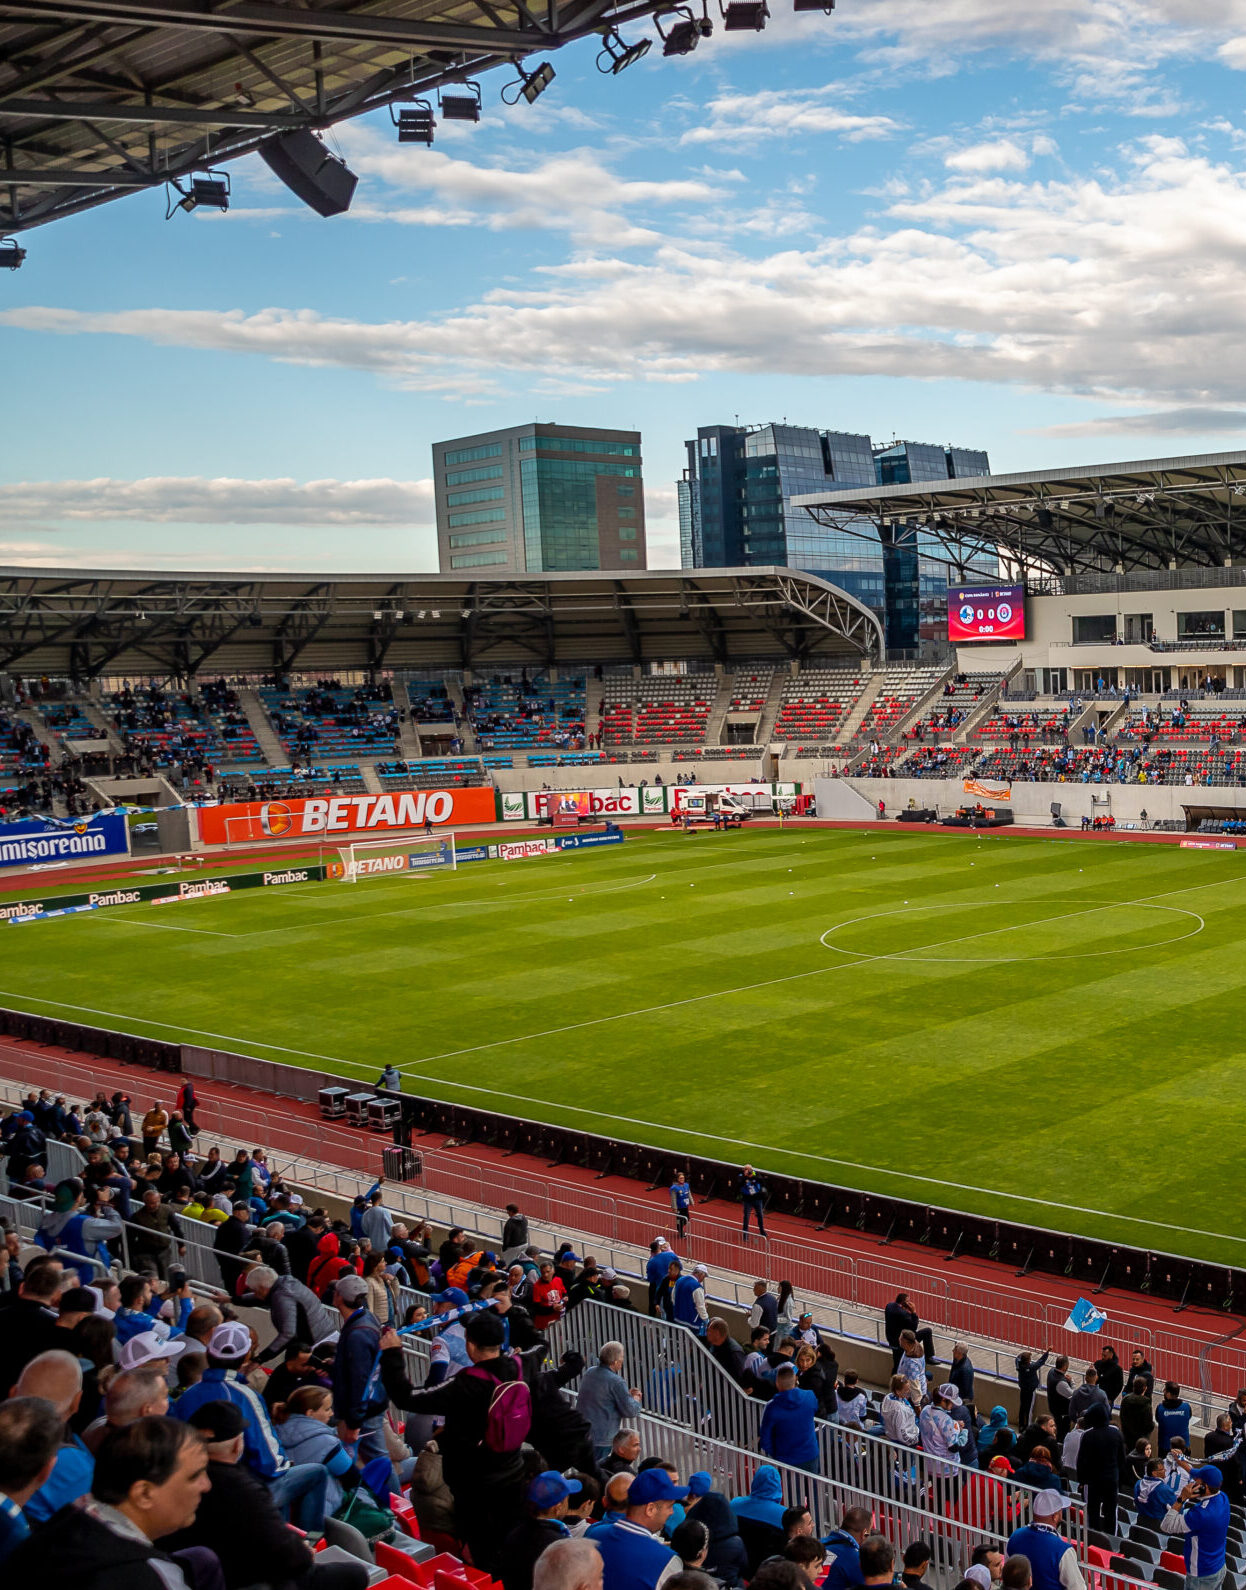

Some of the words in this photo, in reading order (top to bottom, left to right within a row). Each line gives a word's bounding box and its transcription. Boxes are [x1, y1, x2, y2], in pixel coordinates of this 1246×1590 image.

[977, 609, 984, 619] 0
[988, 608, 995, 619] 0
[978, 625, 994, 633] 0:00
[535, 792, 632, 816] Pbac
[302, 791, 454, 833] BETANO
[500, 841, 545, 856] Pambac
[348, 855, 404, 875] BETANO
[264, 870, 308, 885] Pambac
[179, 880, 228, 895] Pambac
[89, 890, 140, 906] Pambac
